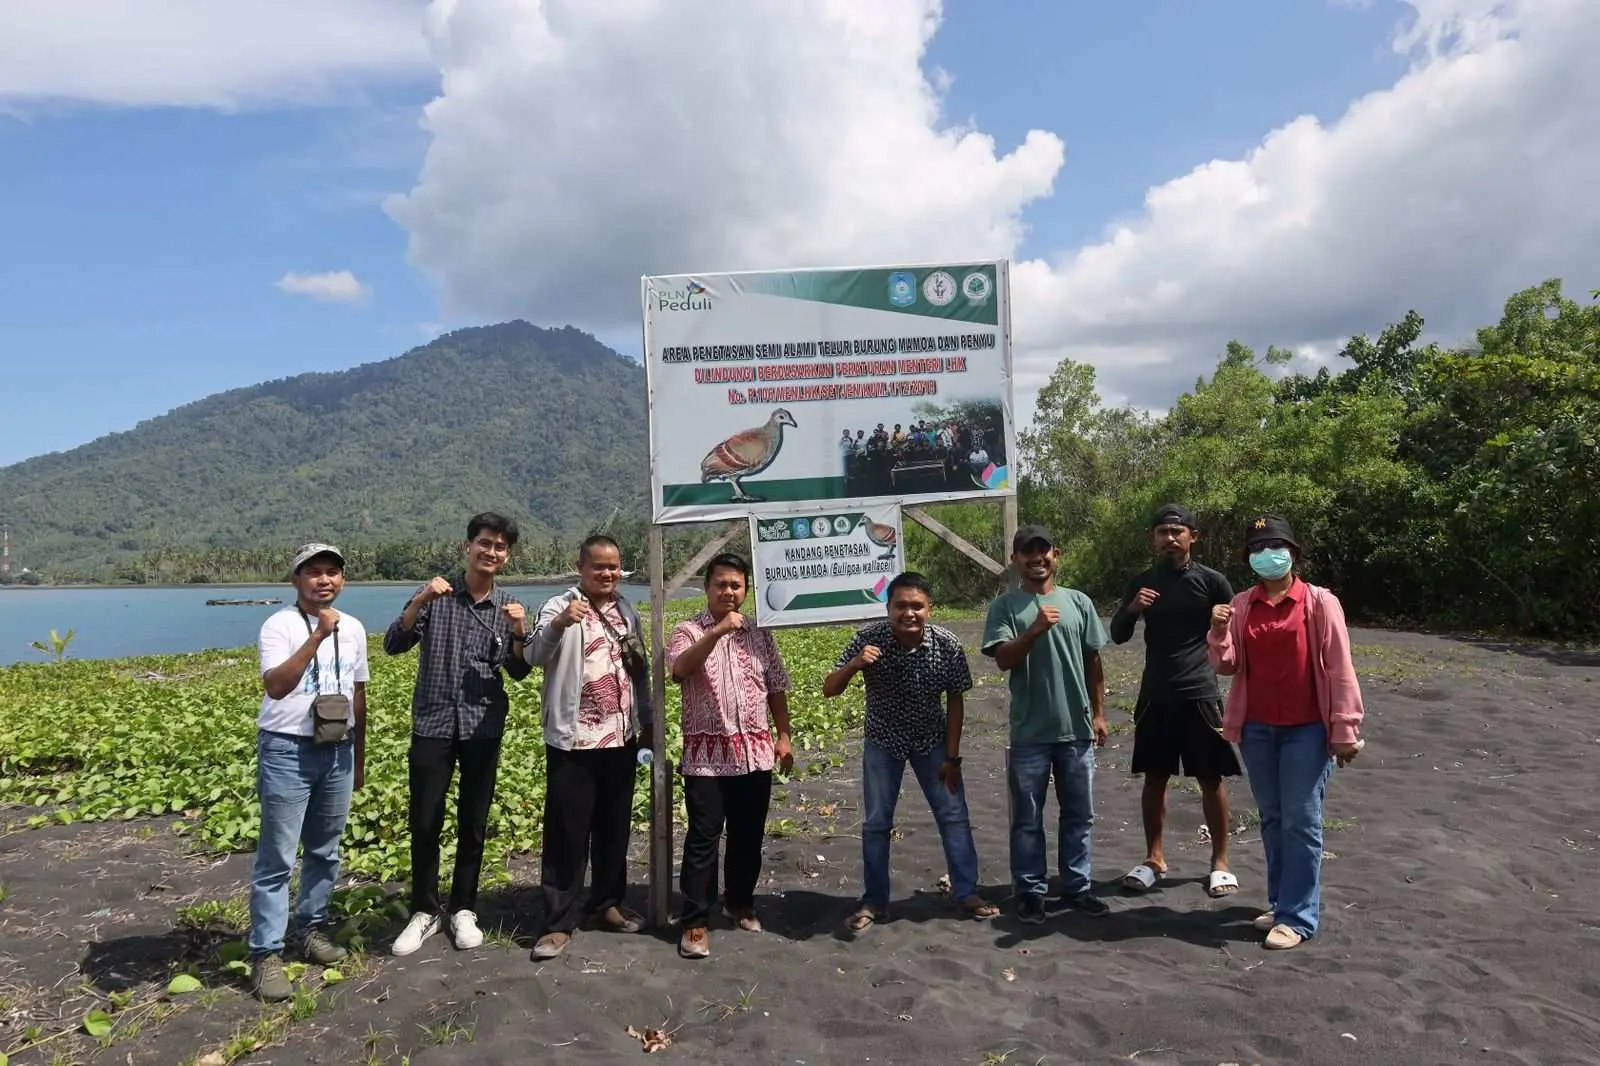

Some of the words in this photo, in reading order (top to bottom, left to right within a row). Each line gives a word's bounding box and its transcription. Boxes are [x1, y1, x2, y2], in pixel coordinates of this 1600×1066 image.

[659, 290, 685, 300] PLN
[660, 296, 712, 312] Peduli
[662, 346, 691, 363] AREA
[692, 344, 753, 362] PENETASAN
[755, 343, 782, 360] SEMI
[783, 341, 817, 358] ALAMI
[818, 340, 852, 357] TELUR
[853, 338, 897, 355] BURUNG
[898, 336, 936, 353] MAMOA
[938, 335, 960, 352] DAN
[960, 333, 995, 350] PENYU
[695, 366, 756, 384] DILINDUNGI
[758, 362, 834, 382] BERDASARKAN
[836, 359, 897, 378] PERATURAN
[898, 357, 944, 375] MENTERI
[945, 356, 967, 372] LHK
[785, 546, 824, 561] KANDANG
[824, 543, 871, 559] PENETASAN
[765, 566, 798, 582] BURUNG
[800, 564, 828, 579] MAMOA
